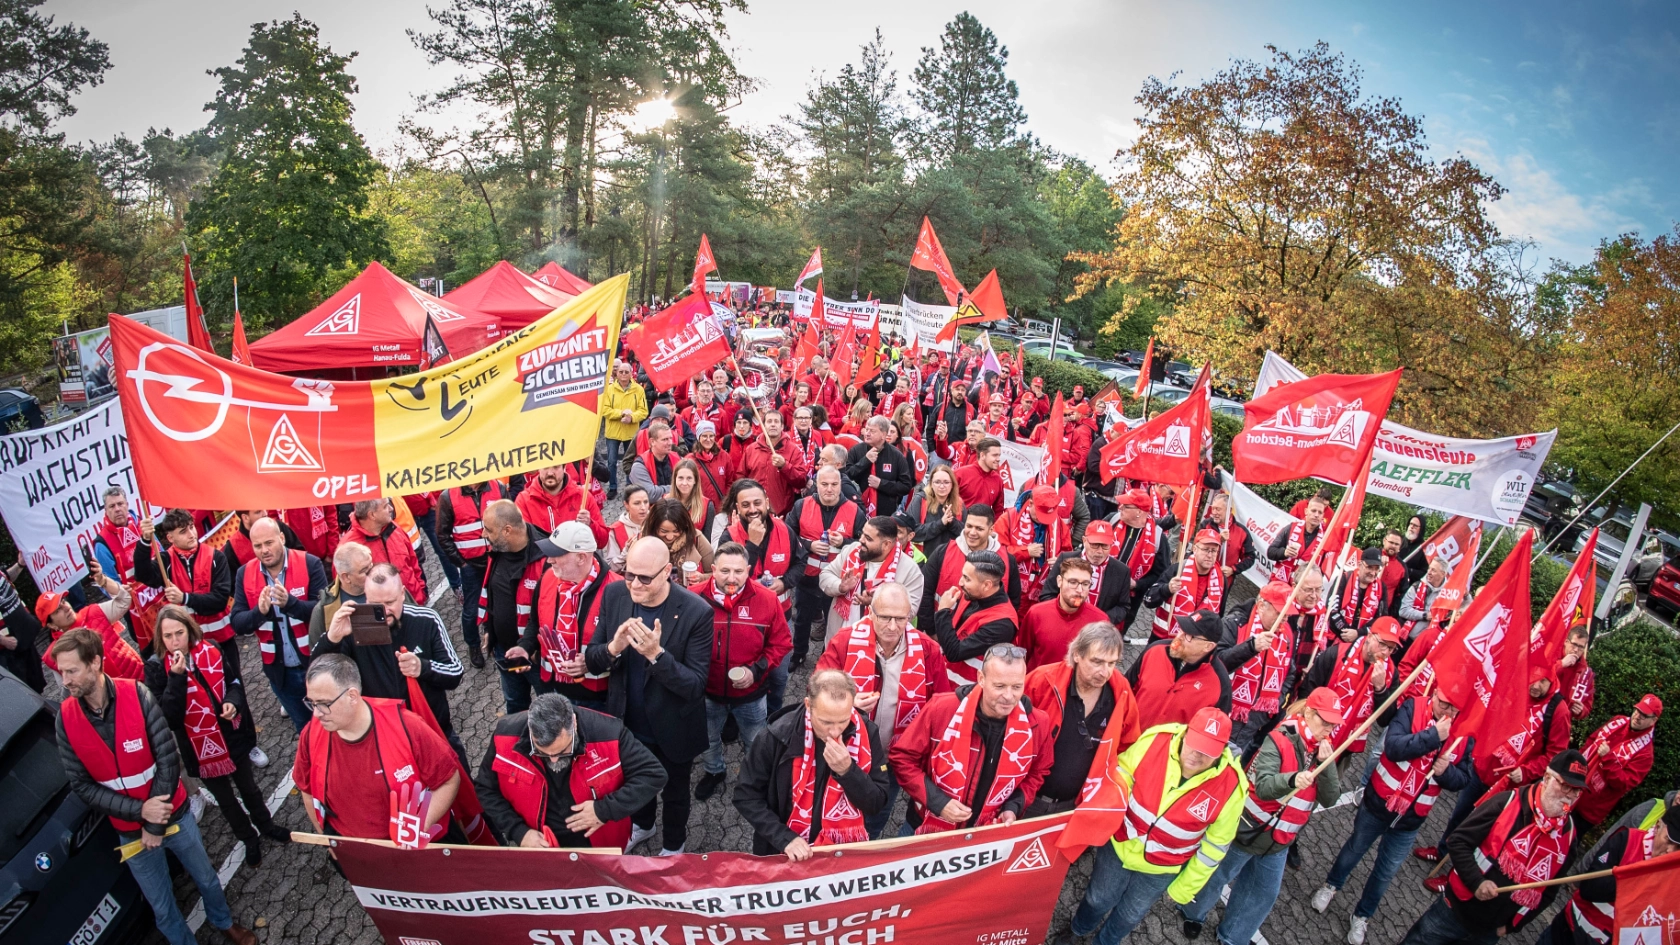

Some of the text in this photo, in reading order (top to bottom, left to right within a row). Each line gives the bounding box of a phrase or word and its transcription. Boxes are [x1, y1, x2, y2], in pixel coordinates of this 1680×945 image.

[373, 353, 411, 362] Hanau-Fulda
[518, 327, 606, 373] ZUKUNFT
[523, 353, 609, 392] SICHERN
[535, 386, 566, 400] GEMEINSAM
[566, 384, 579, 394] SIND
[578, 383, 589, 391] WIR
[0, 407, 110, 475] AUFKRAFT
[22, 434, 129, 508] WACHSTU
[386, 438, 566, 489] KAISERSLAUTERN
[1370, 458, 1472, 490] AEFFLER
[312, 474, 379, 499] OPEL
[1370, 478, 1413, 498] Homburg
[1265, 520, 1280, 533] IG
[401, 815, 417, 843] 5
[370, 848, 1003, 914] VERTRAUENSLEUTE DAIMLER TRUCK WERK KASSEL
[528, 904, 912, 945] STARK FÜR EUCH,
[976, 927, 1030, 943] IG METALL
